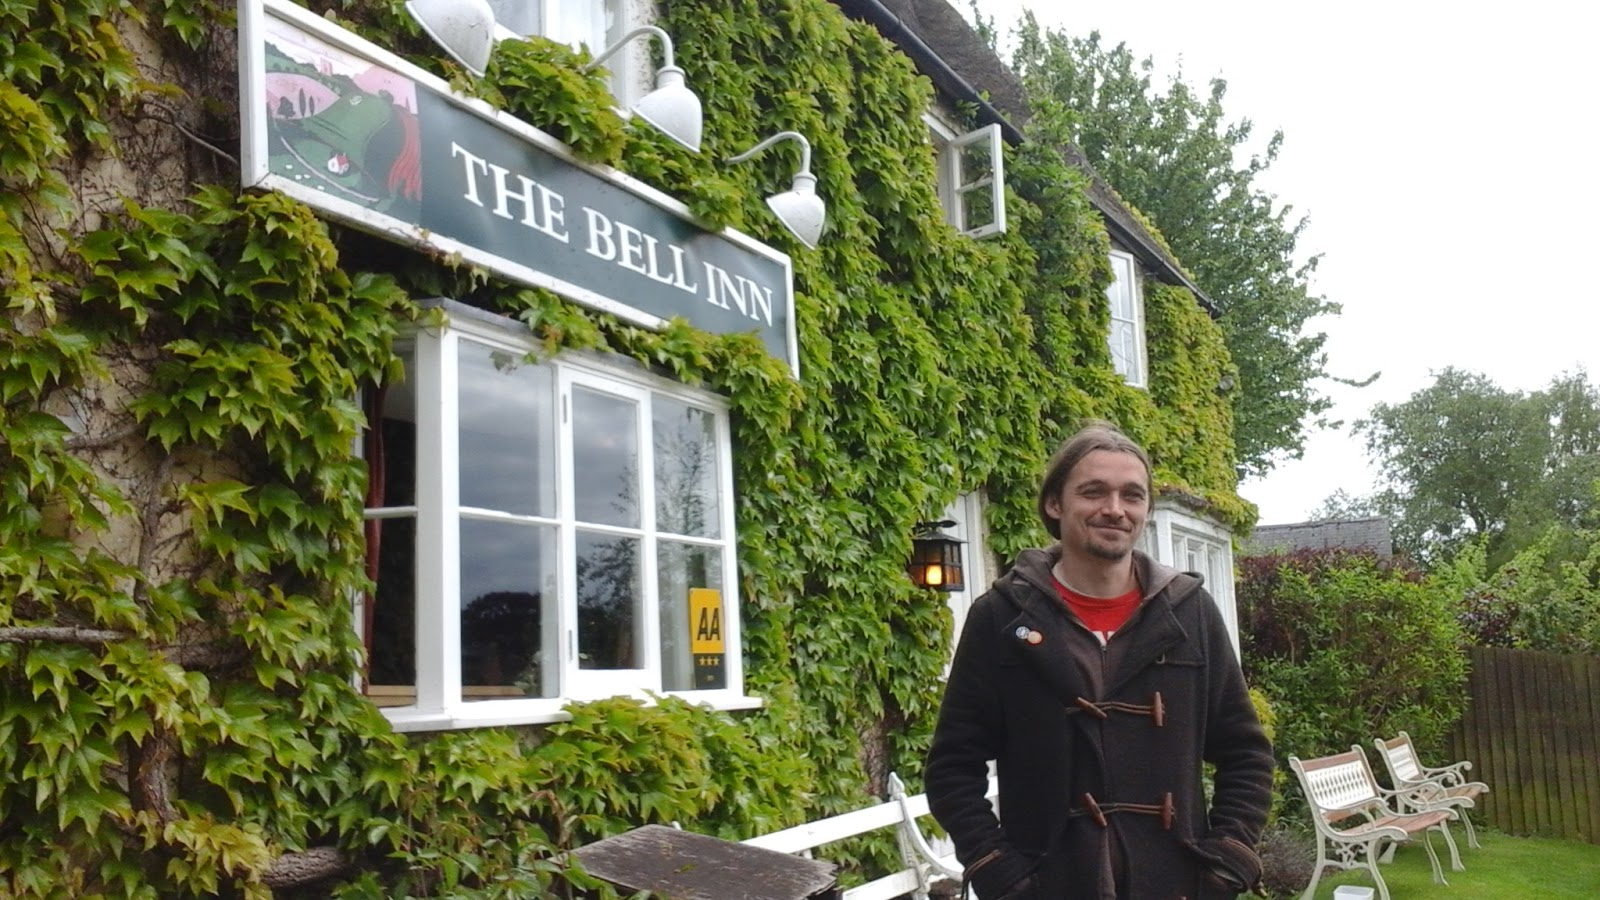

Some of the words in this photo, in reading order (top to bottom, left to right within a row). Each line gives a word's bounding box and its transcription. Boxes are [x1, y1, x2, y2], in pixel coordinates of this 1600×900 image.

[452, 141, 569, 243] THE
[582, 206, 697, 294] BELL
[703, 261, 773, 327] INN
[697, 607, 720, 640] AA
